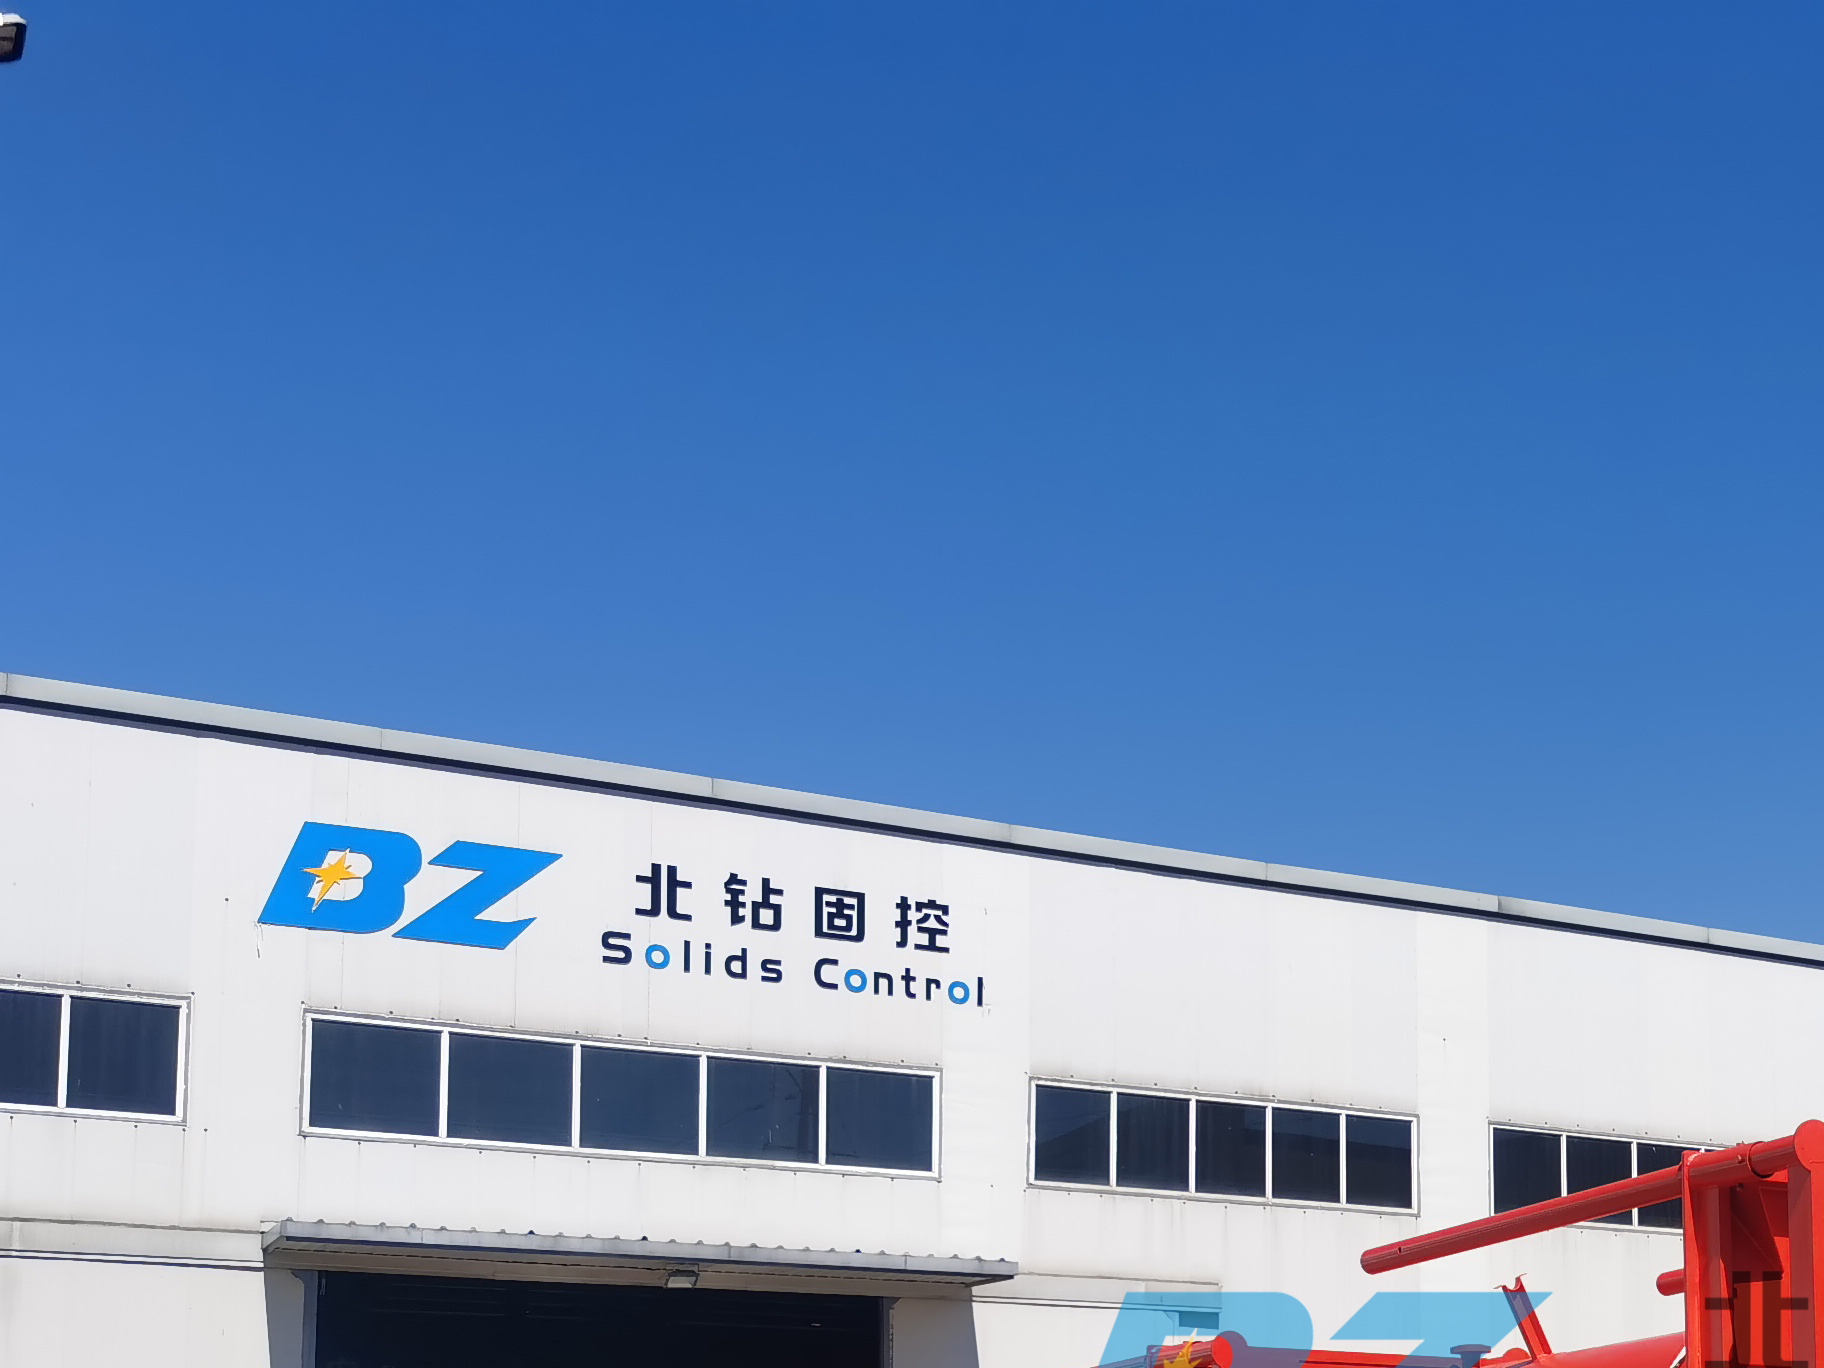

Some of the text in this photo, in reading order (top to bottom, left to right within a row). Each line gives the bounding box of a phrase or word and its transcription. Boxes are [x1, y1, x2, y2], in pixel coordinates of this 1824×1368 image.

[258, 821, 563, 951] BZ
[635, 862, 951, 955] 北钻固控
[601, 930, 986, 1008] Solids Control
